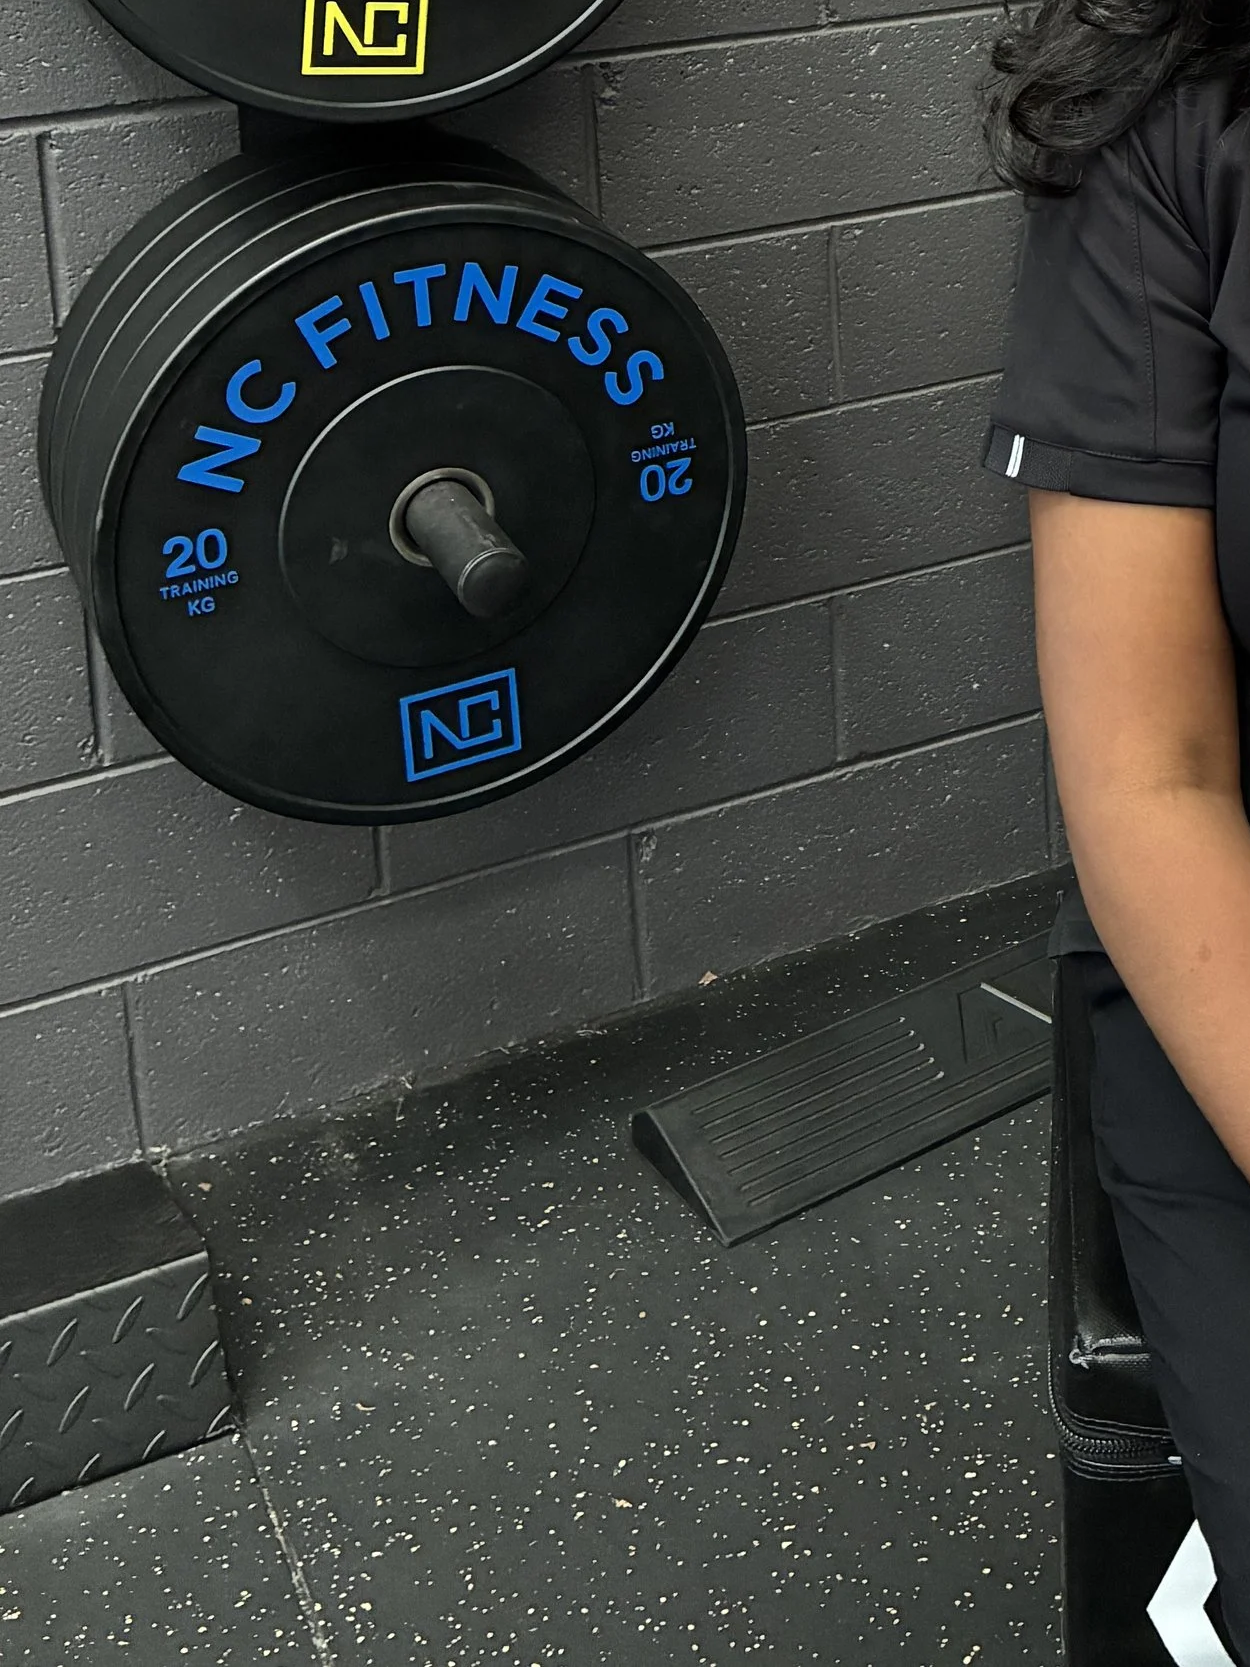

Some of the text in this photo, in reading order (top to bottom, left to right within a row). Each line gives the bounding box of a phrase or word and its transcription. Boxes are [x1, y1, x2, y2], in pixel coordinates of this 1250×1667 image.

[177, 262, 664, 492] NC FITNESS
[651, 422, 674, 439] KG
[631, 438, 696, 462] TRAINING
[640, 458, 692, 501] 20
[163, 529, 227, 578] 20
[160, 571, 238, 599] TRAINING
[188, 597, 215, 615] KG
